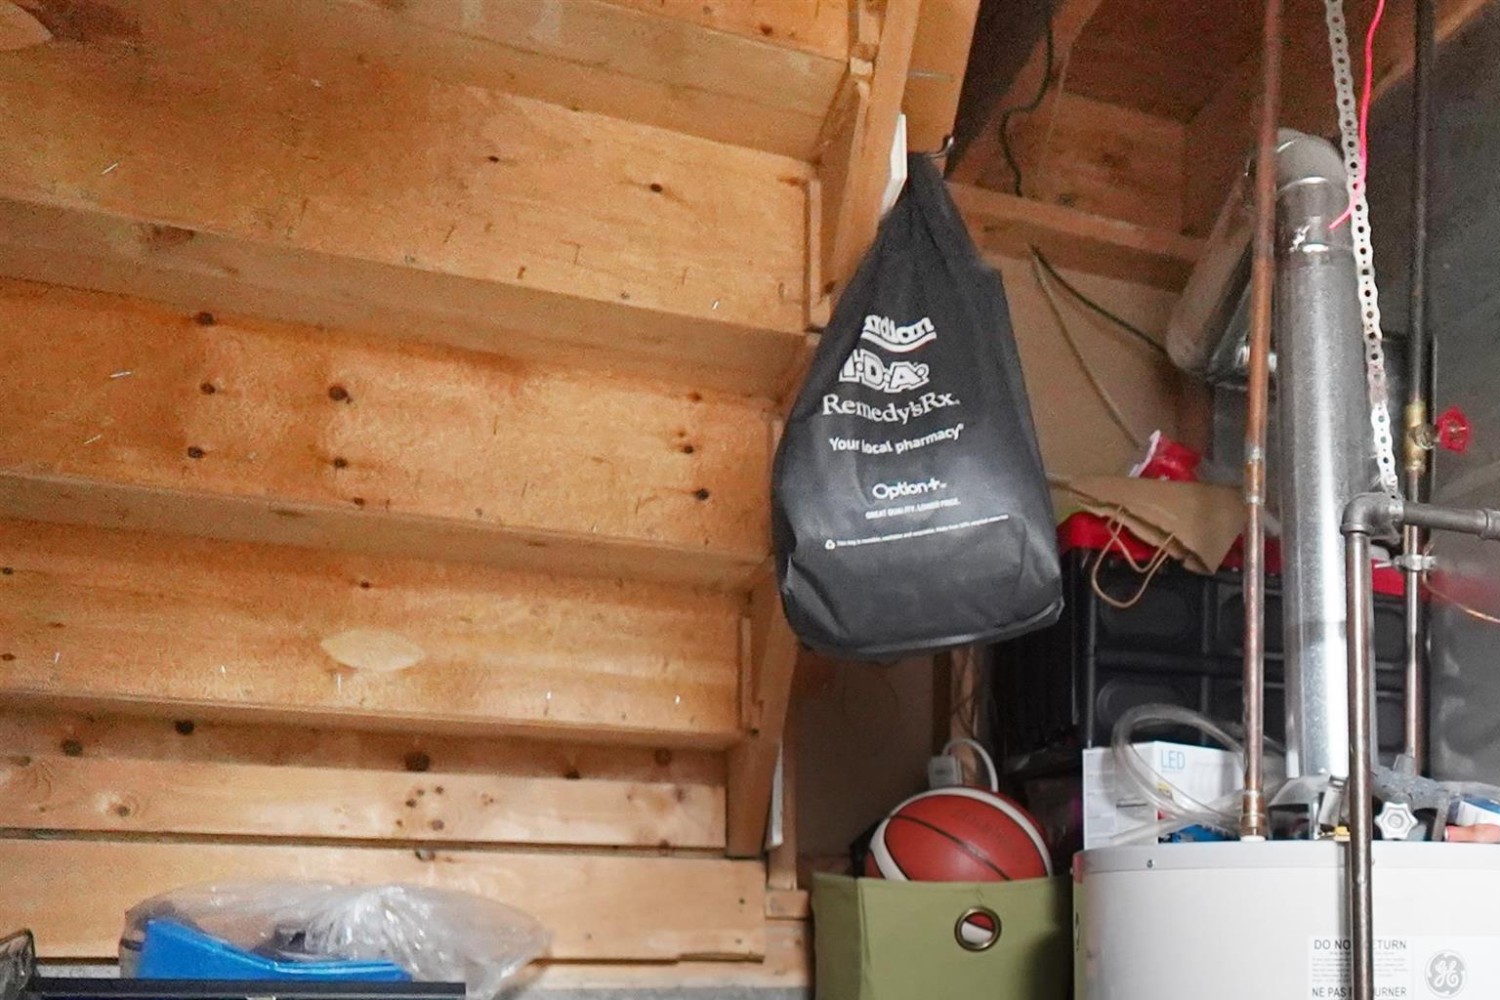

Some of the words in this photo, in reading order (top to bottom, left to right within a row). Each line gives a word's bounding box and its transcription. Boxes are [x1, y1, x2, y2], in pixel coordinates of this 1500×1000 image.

[829, 437, 860, 451] Your
[861, 440, 893, 455] local
[895, 423, 963, 455] pharmacy
[1161, 750, 1185, 770] LED
[1314, 939, 1331, 950] DO
[1335, 939, 1352, 950] NO
[1312, 987, 1325, 997] NE
[1328, 987, 1347, 997] PAS
